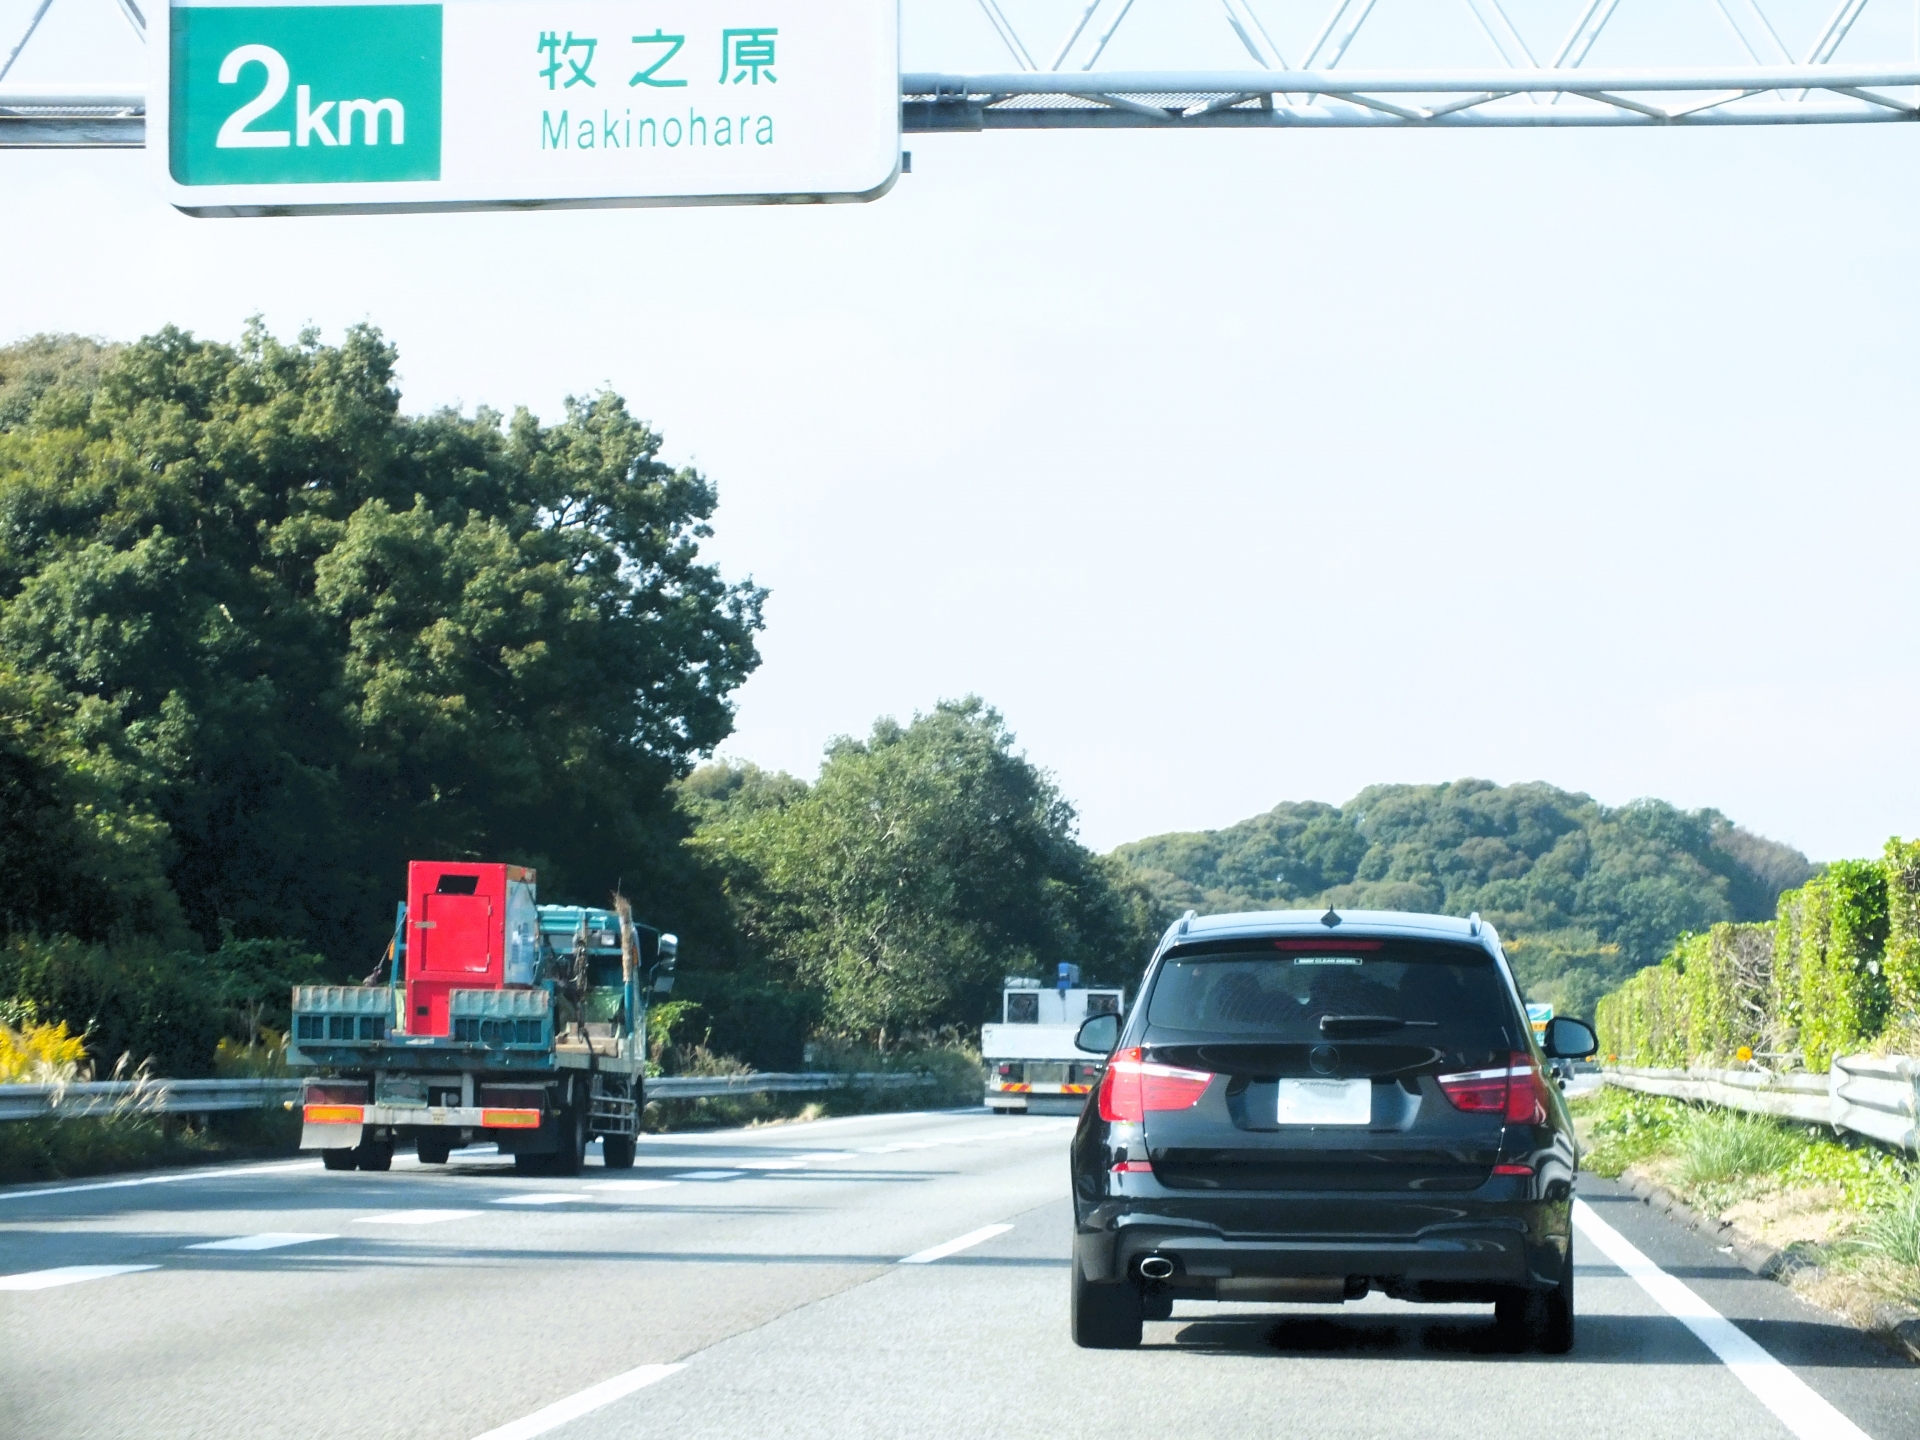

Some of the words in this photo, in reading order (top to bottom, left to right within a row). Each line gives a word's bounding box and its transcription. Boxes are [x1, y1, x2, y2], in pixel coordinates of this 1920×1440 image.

[537, 27, 779, 91] 牧之原
[215, 43, 405, 149] 2km
[541, 107, 774, 150] Makinohara
